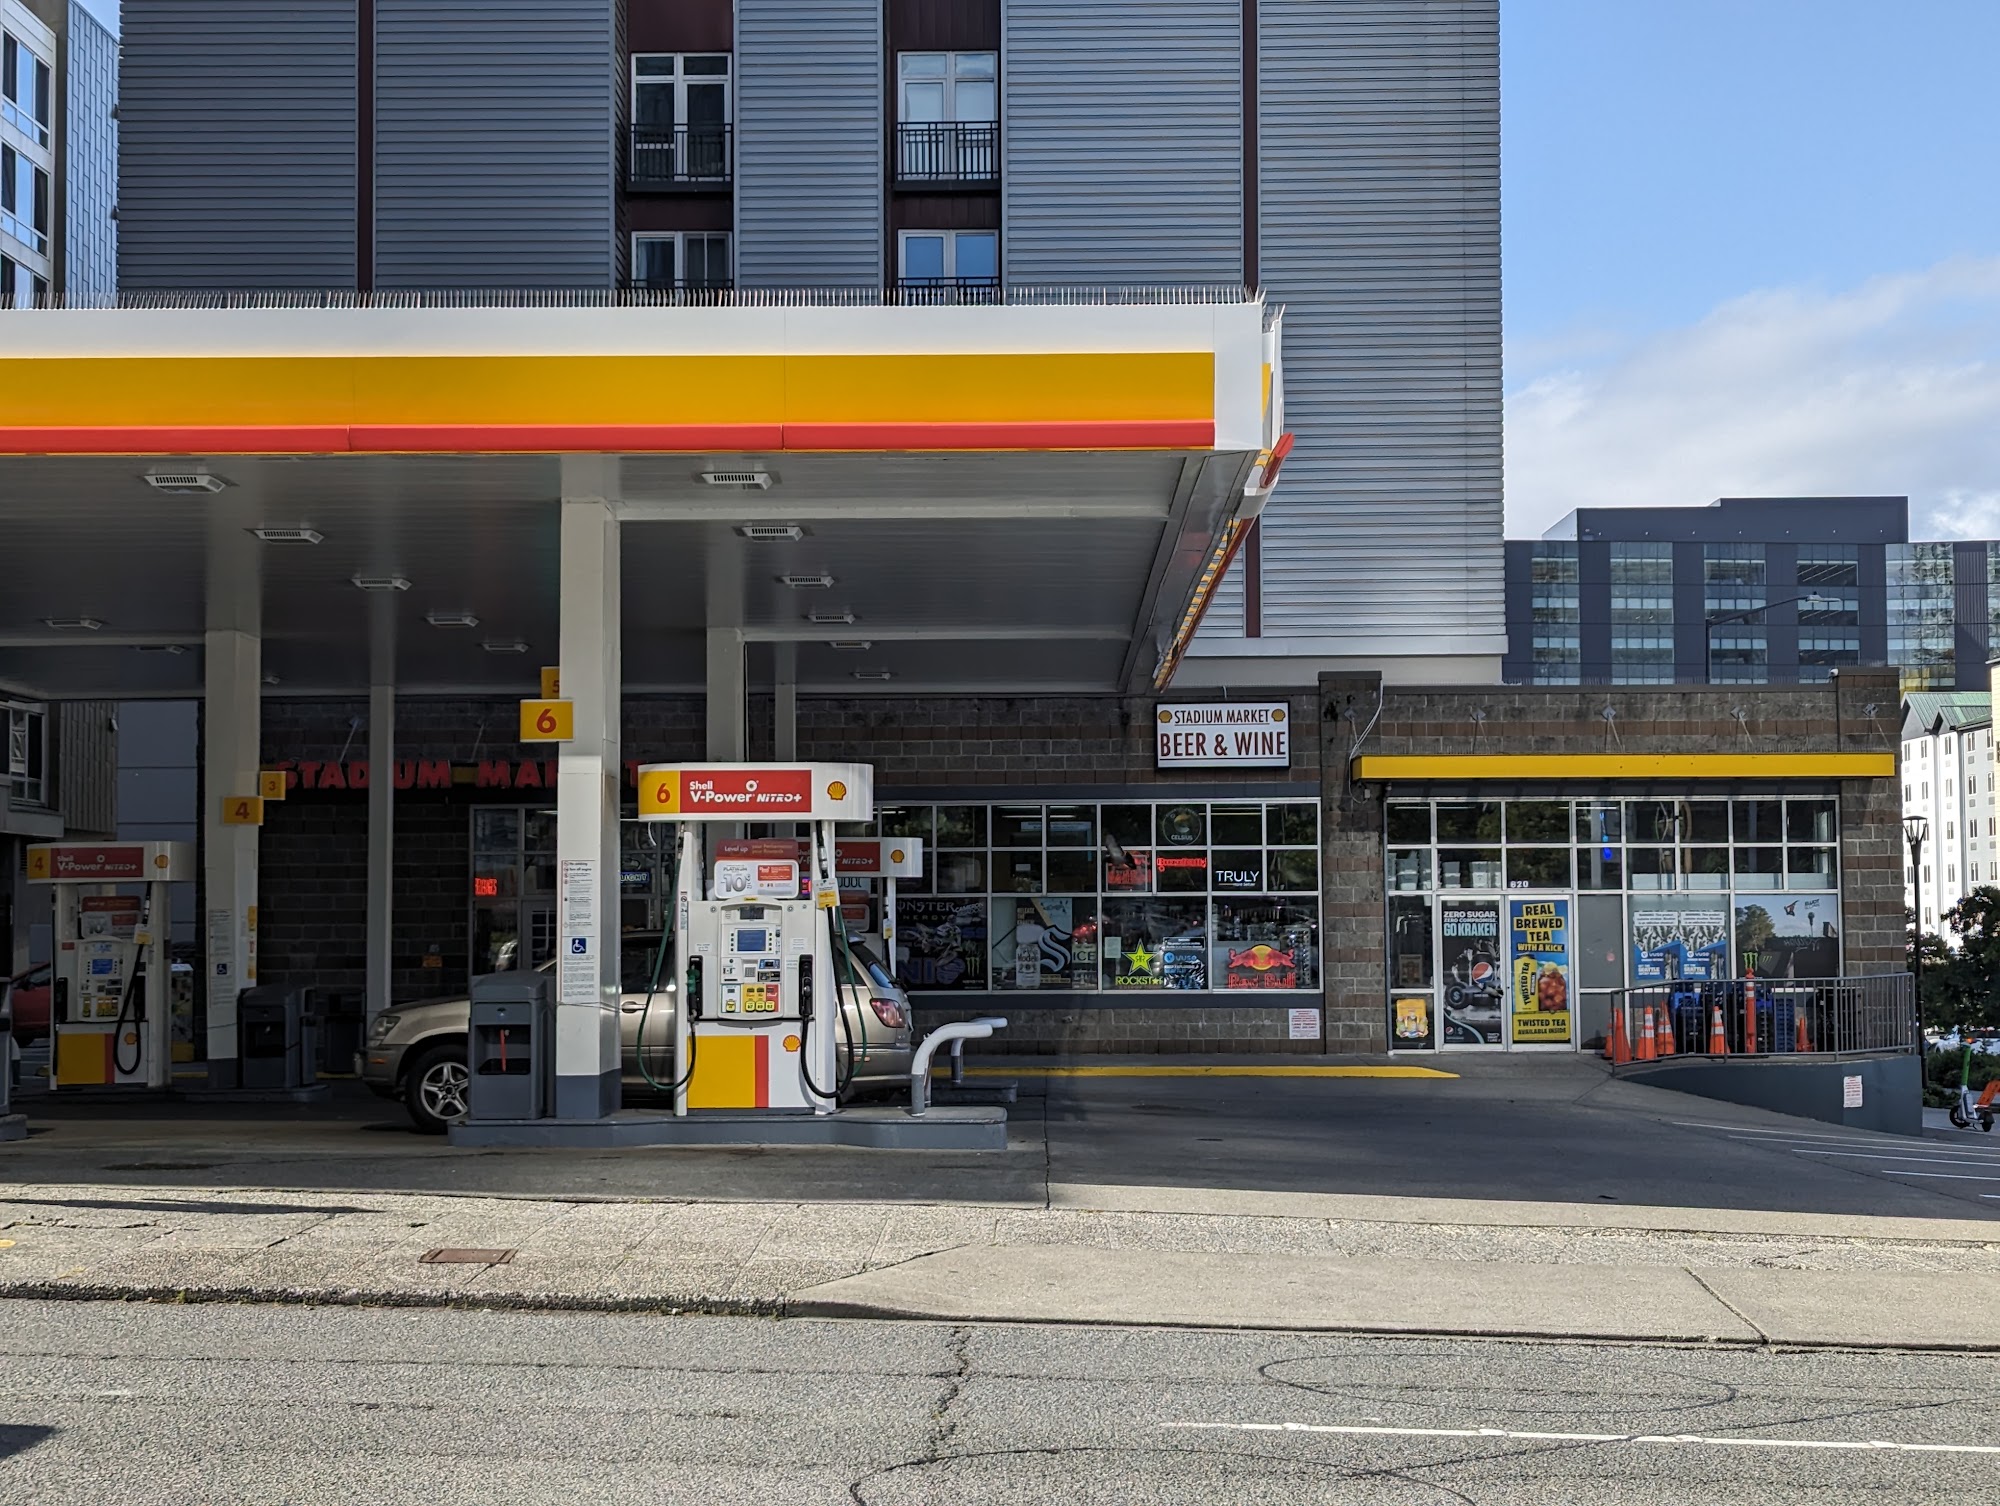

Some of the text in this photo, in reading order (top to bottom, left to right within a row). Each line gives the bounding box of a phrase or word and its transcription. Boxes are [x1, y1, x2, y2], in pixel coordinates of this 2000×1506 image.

[552, 680, 560, 693] 5
[536, 708, 557, 734] 6
[1174, 709, 1270, 724] STADIUM MARKET
[1160, 731, 1286, 757] BEER & WINE
[274, 760, 452, 790] STADUM
[268, 780, 276, 792] 3
[689, 780, 713, 790] Shell
[656, 783, 671, 804] 6
[690, 790, 752, 802] V-Power
[235, 802, 250, 819] 4
[34, 857, 44, 871] 4
[1216, 870, 1259, 882] TRULY
[724, 874, 746, 892] 10
[897, 900, 956, 912] ONSTER
[1525, 904, 1553, 916] REAL
[1443, 922, 1497, 936] GO KRAKEN
[1516, 918, 1563, 929] BREWED
[1529, 931, 1550, 942] TEA
[1073, 951, 1096, 961] ICE
[1229, 972, 1297, 988] Red Bull
[1521, 976, 1531, 1005] TWISTED
[1518, 1019, 1550, 1027] TWISTED
